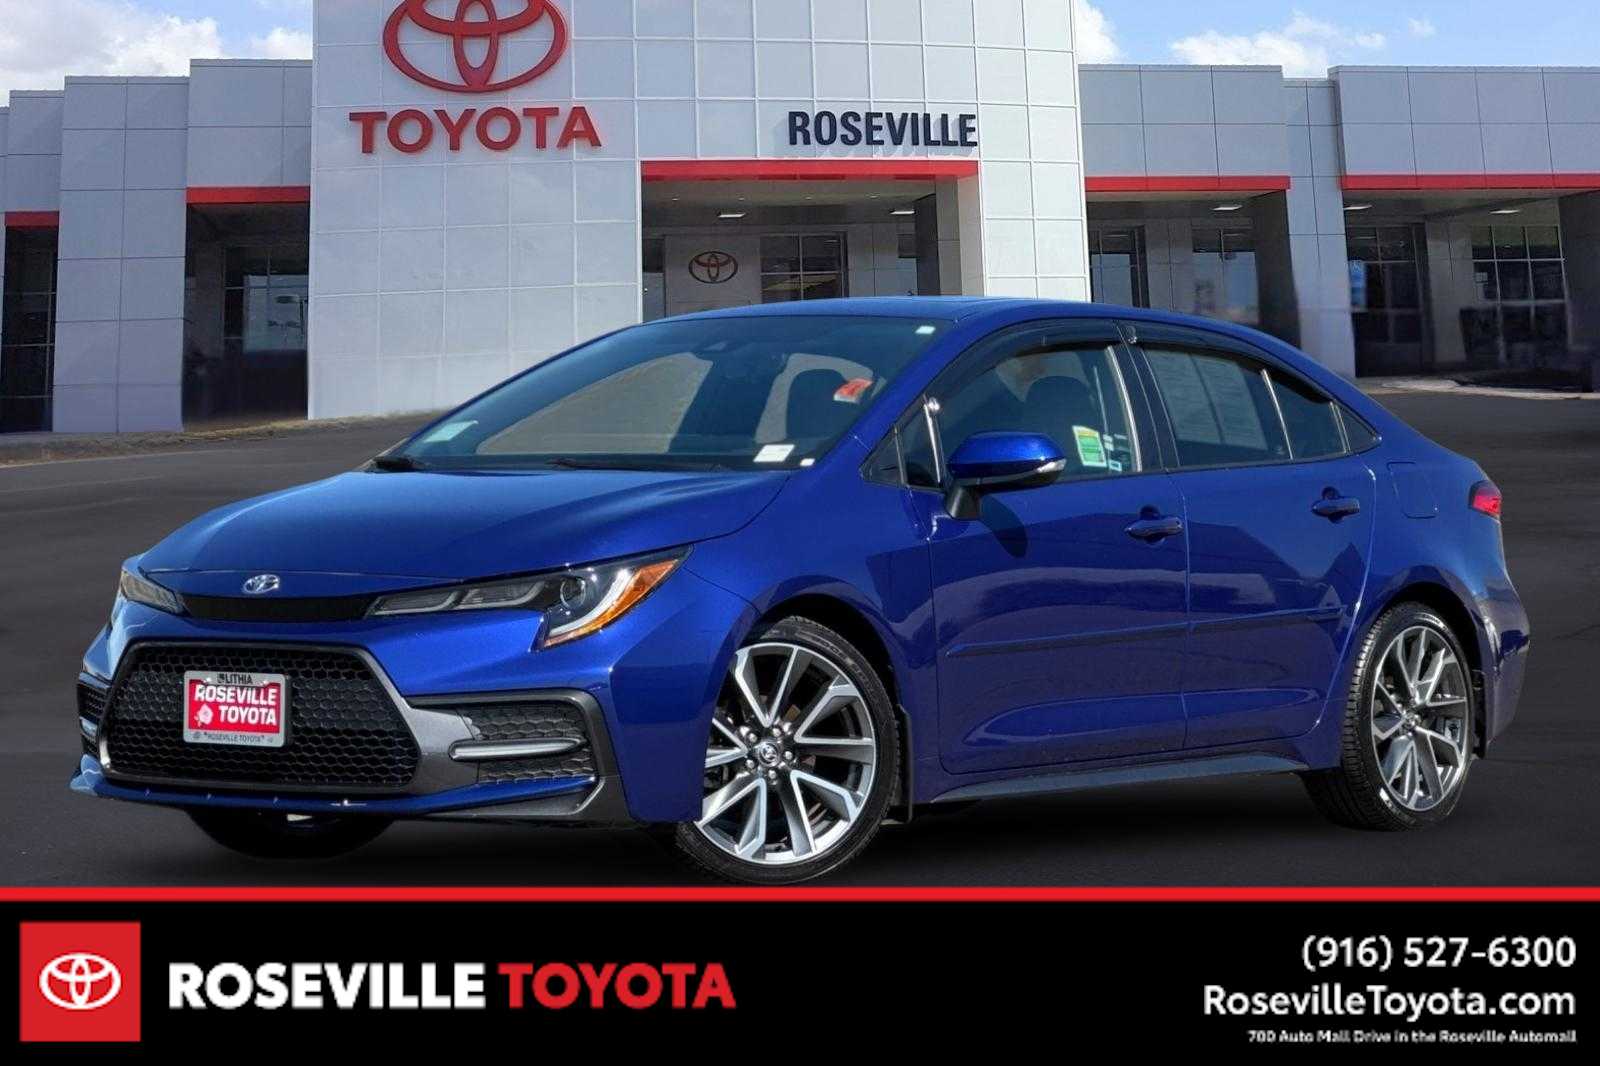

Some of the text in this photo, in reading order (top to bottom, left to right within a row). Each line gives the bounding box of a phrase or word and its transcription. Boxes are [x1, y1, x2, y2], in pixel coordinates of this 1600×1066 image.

[349, 106, 602, 153] TOYOTA
[788, 111, 978, 147] ROSEVILLE
[225, 673, 253, 685] LITHIA
[194, 684, 278, 706] ROSEVILLE
[218, 705, 277, 726] TOYOTA
